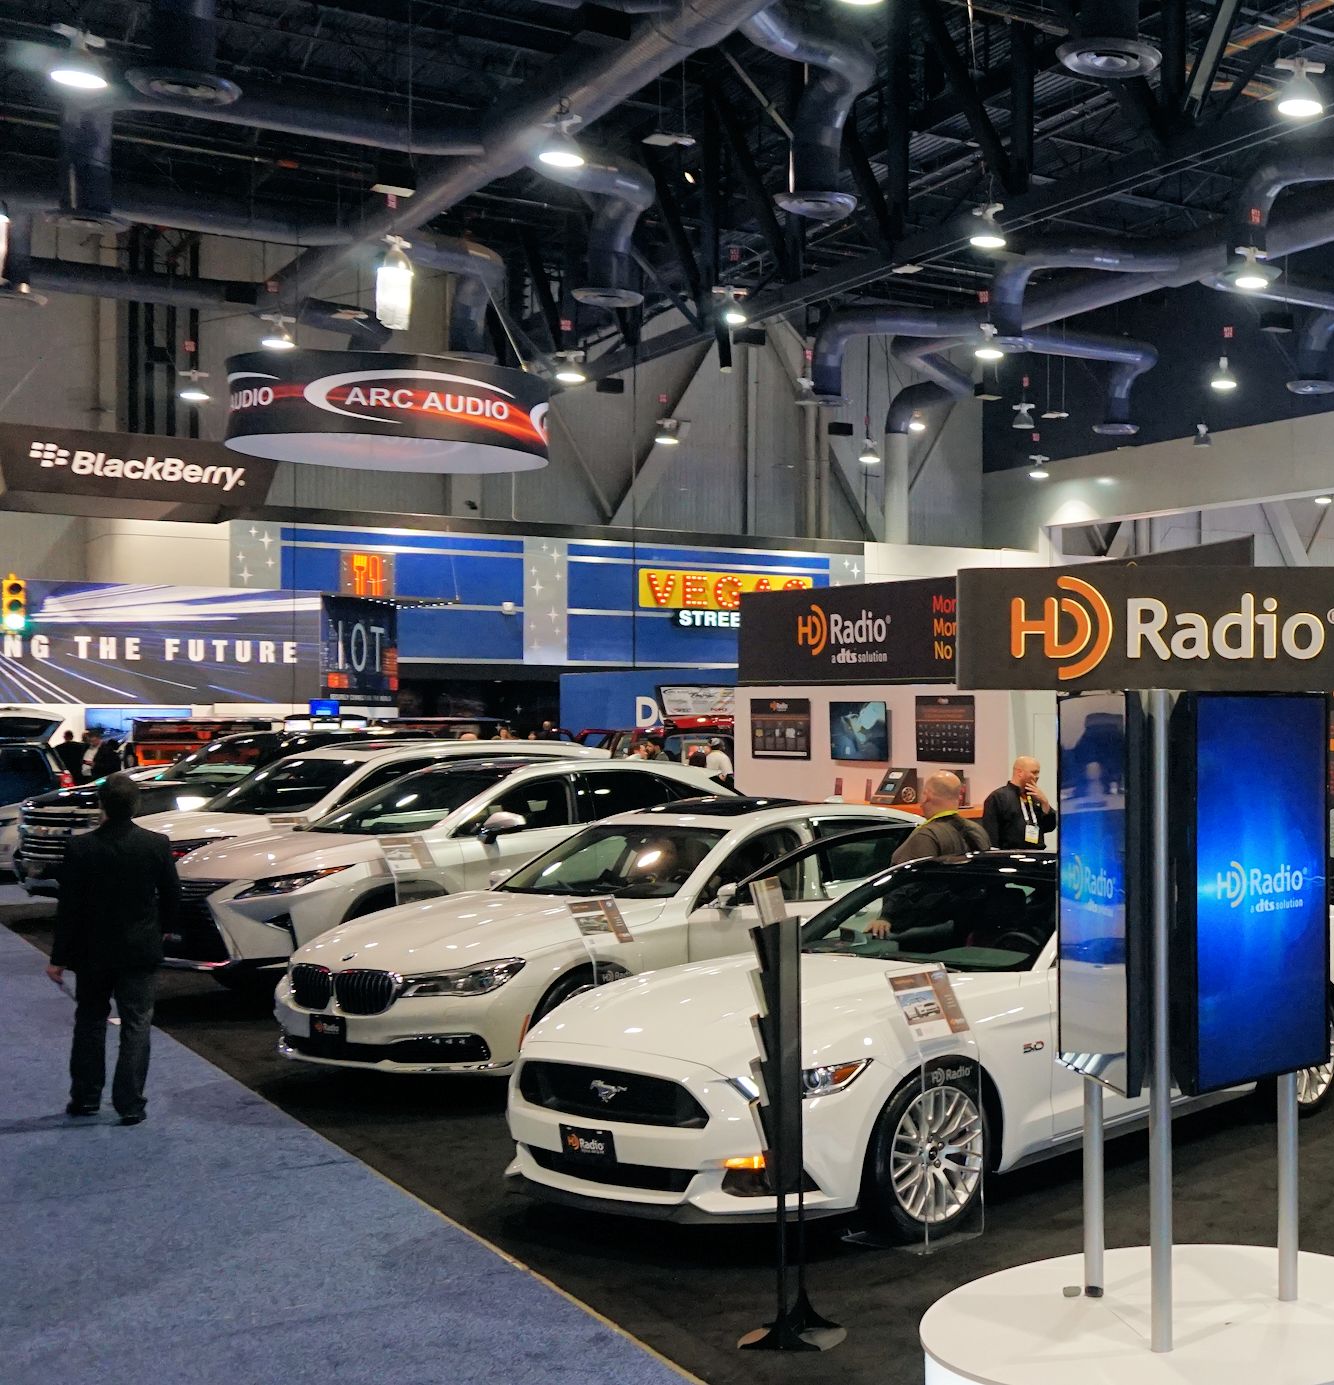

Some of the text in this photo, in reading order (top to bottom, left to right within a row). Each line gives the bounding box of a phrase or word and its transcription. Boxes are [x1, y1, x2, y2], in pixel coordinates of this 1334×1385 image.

[230, 386, 509, 420] UDIO ARC AUDIO
[71, 450, 245, 491] BlackBerry
[933, 595, 957, 613] Mor
[679, 610, 741, 627] STREE
[797, 604, 828, 656] HD
[934, 618, 957, 636] Mor
[1011, 576, 1112, 680] HD
[74, 635, 141, 660] THE
[165, 638, 298, 664] FUTURE
[337, 620, 385, 673] IOT
[831, 649, 888, 664] a dts solution
[934, 641, 953, 659] No
[1217, 861, 1247, 908] HD
[1255, 898, 1274, 912] dts
[1275, 898, 1303, 911] solution
[579, 1138, 604, 1151] Radio
